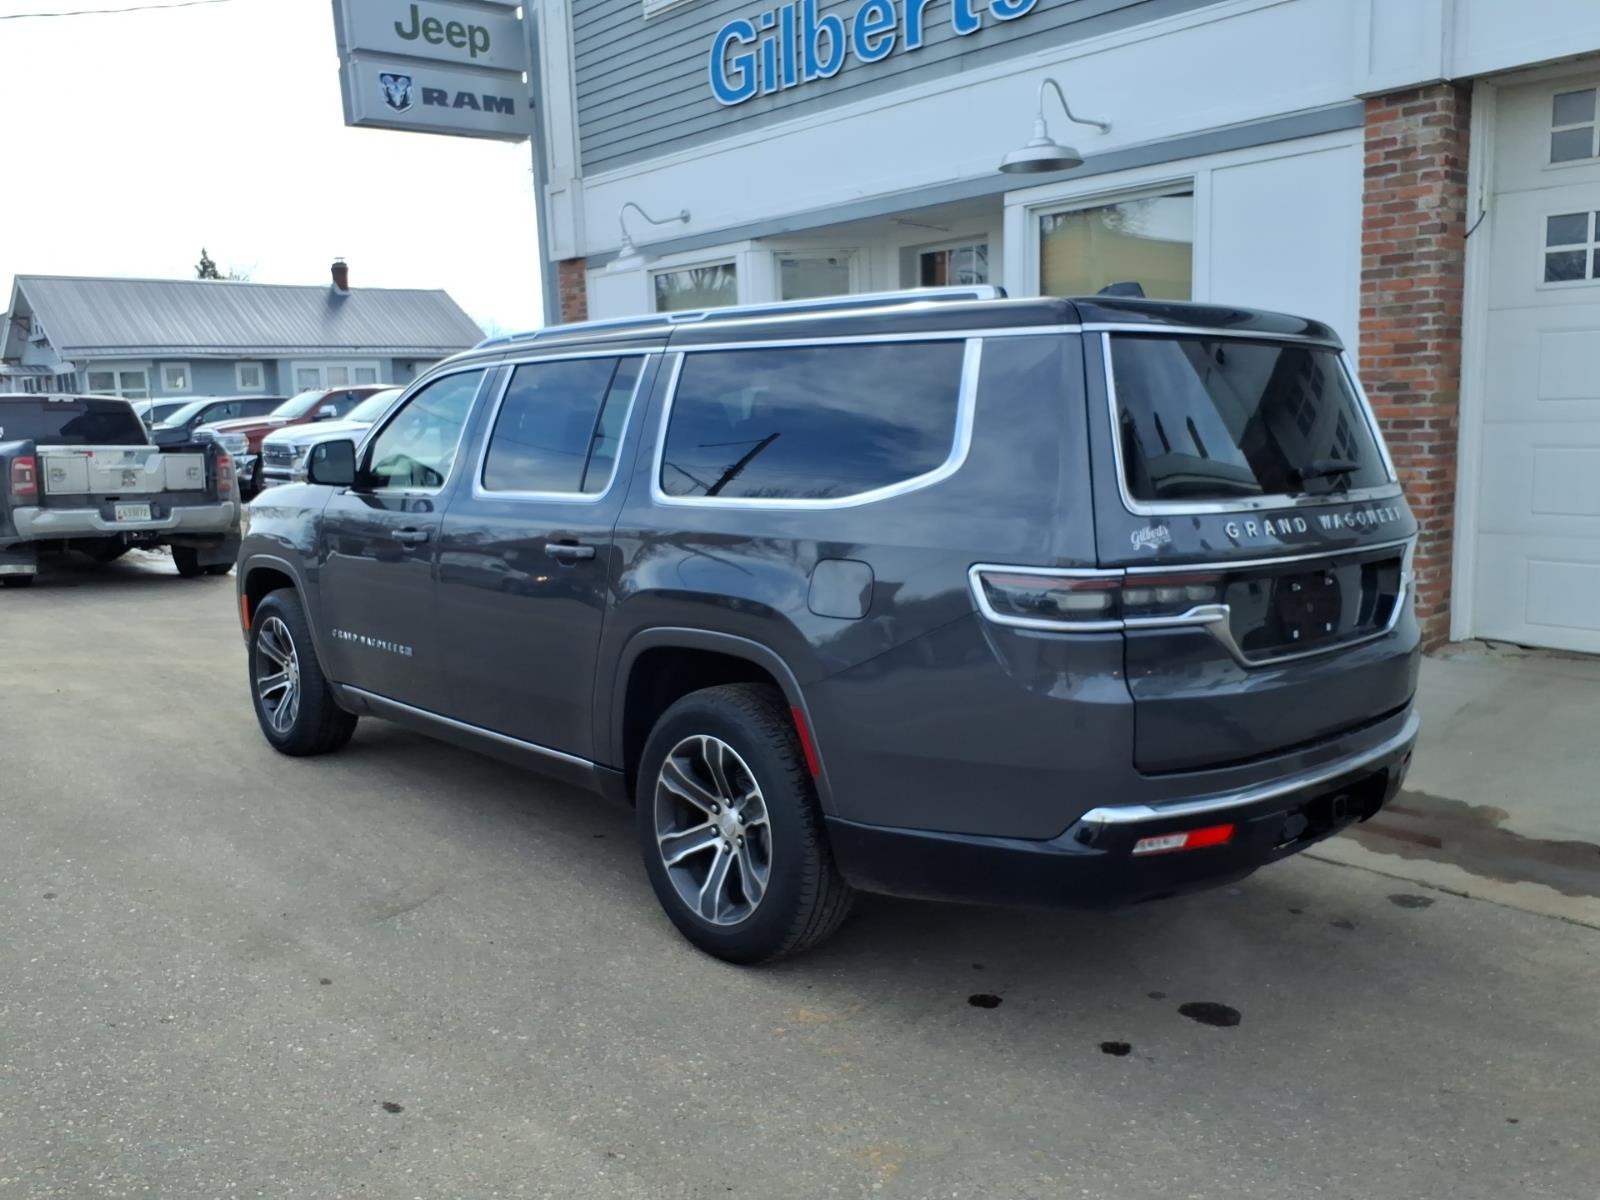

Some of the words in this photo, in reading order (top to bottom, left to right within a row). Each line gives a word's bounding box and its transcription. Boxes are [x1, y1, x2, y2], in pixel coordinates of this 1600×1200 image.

[394, 3, 491, 58] Jeep
[708, 0, 1038, 106] Gilber
[421, 87, 515, 116] RAM
[1225, 516, 1308, 538] GRAND
